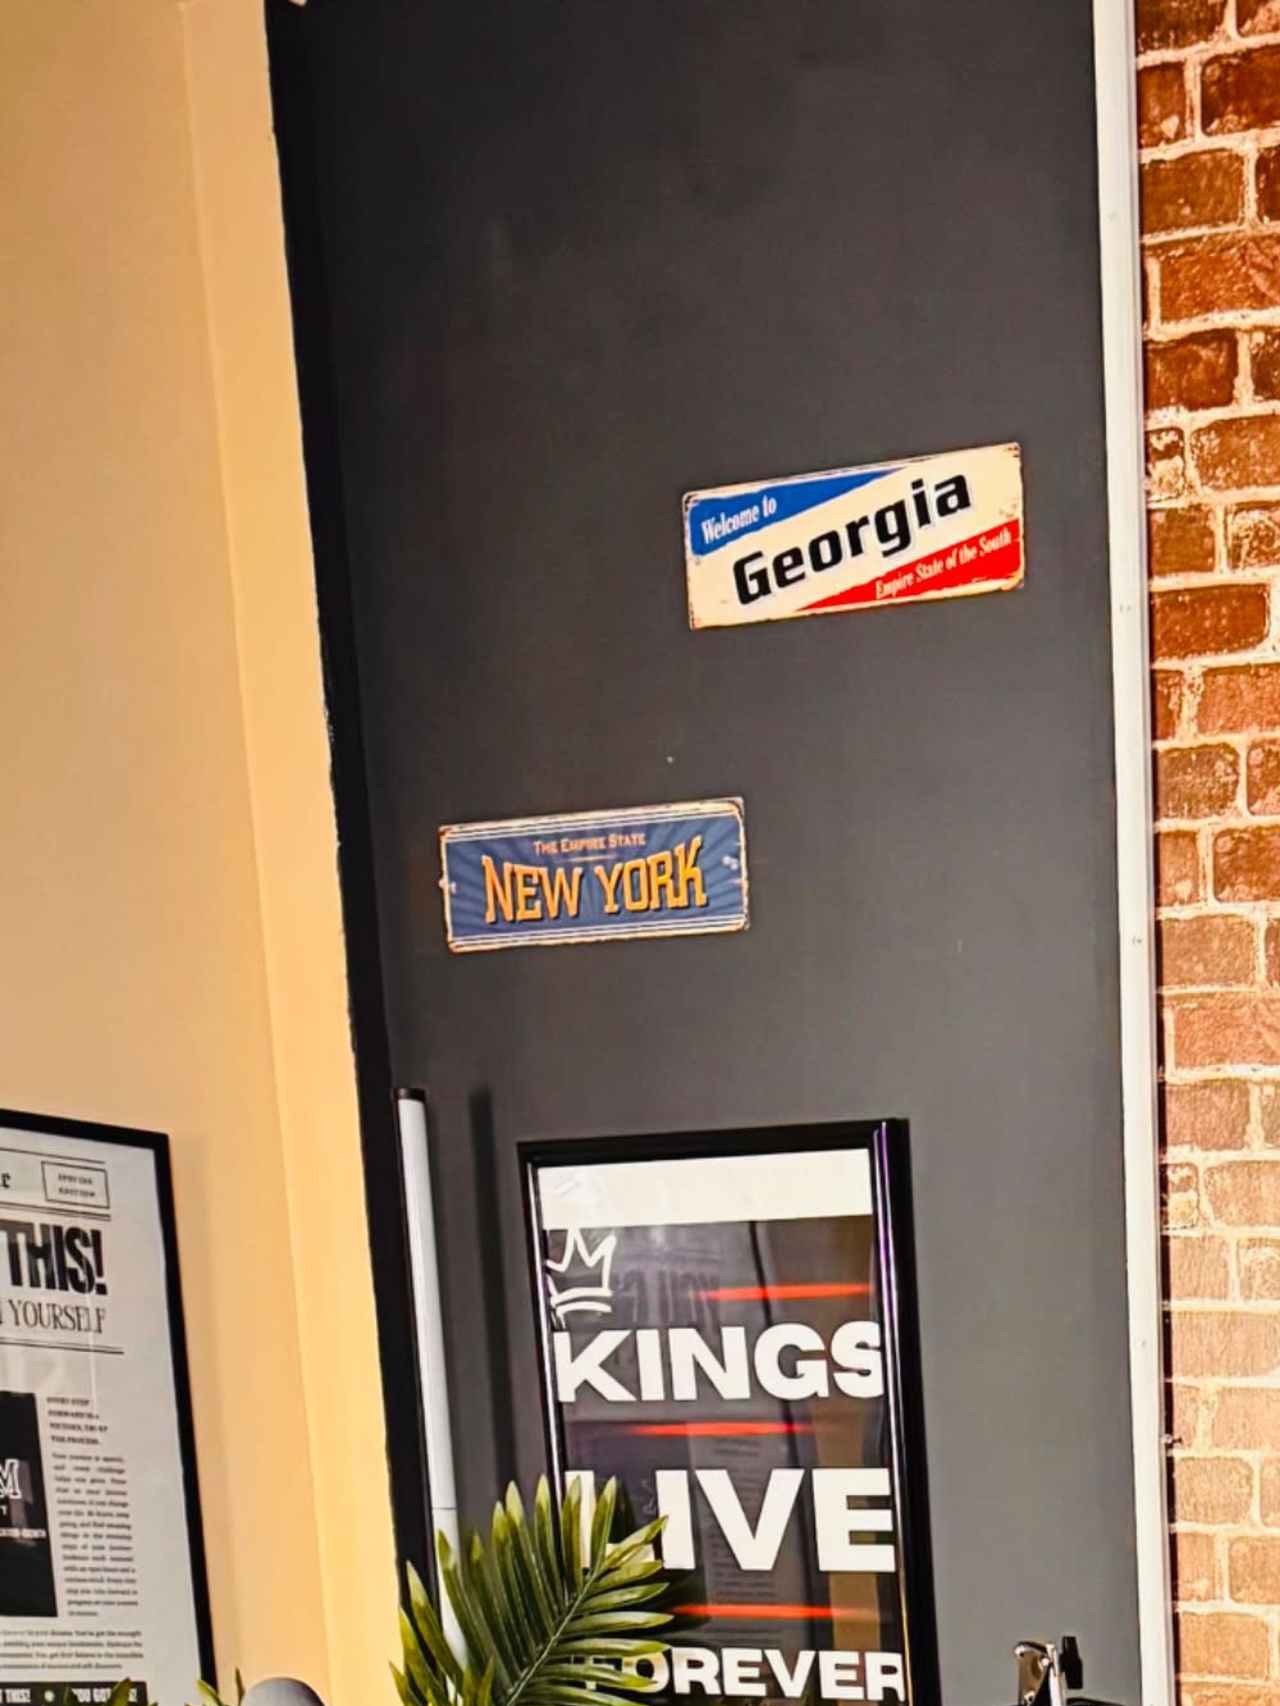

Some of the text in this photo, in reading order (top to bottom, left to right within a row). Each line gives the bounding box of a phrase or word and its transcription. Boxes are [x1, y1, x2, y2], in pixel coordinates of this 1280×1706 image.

[701, 495, 777, 544] Welcome to
[732, 474, 971, 605] Georgia
[875, 529, 1012, 600] Empire State of the South
[481, 834, 708, 924] NEW YORK
[533, 832, 646, 855] THE EMPIRE STATE
[0, 1219, 108, 1295] THIS!
[9, 1300, 107, 1335] YOURSELF
[553, 1320, 885, 1402] KINGS
[564, 1468, 897, 1573] LIVE
